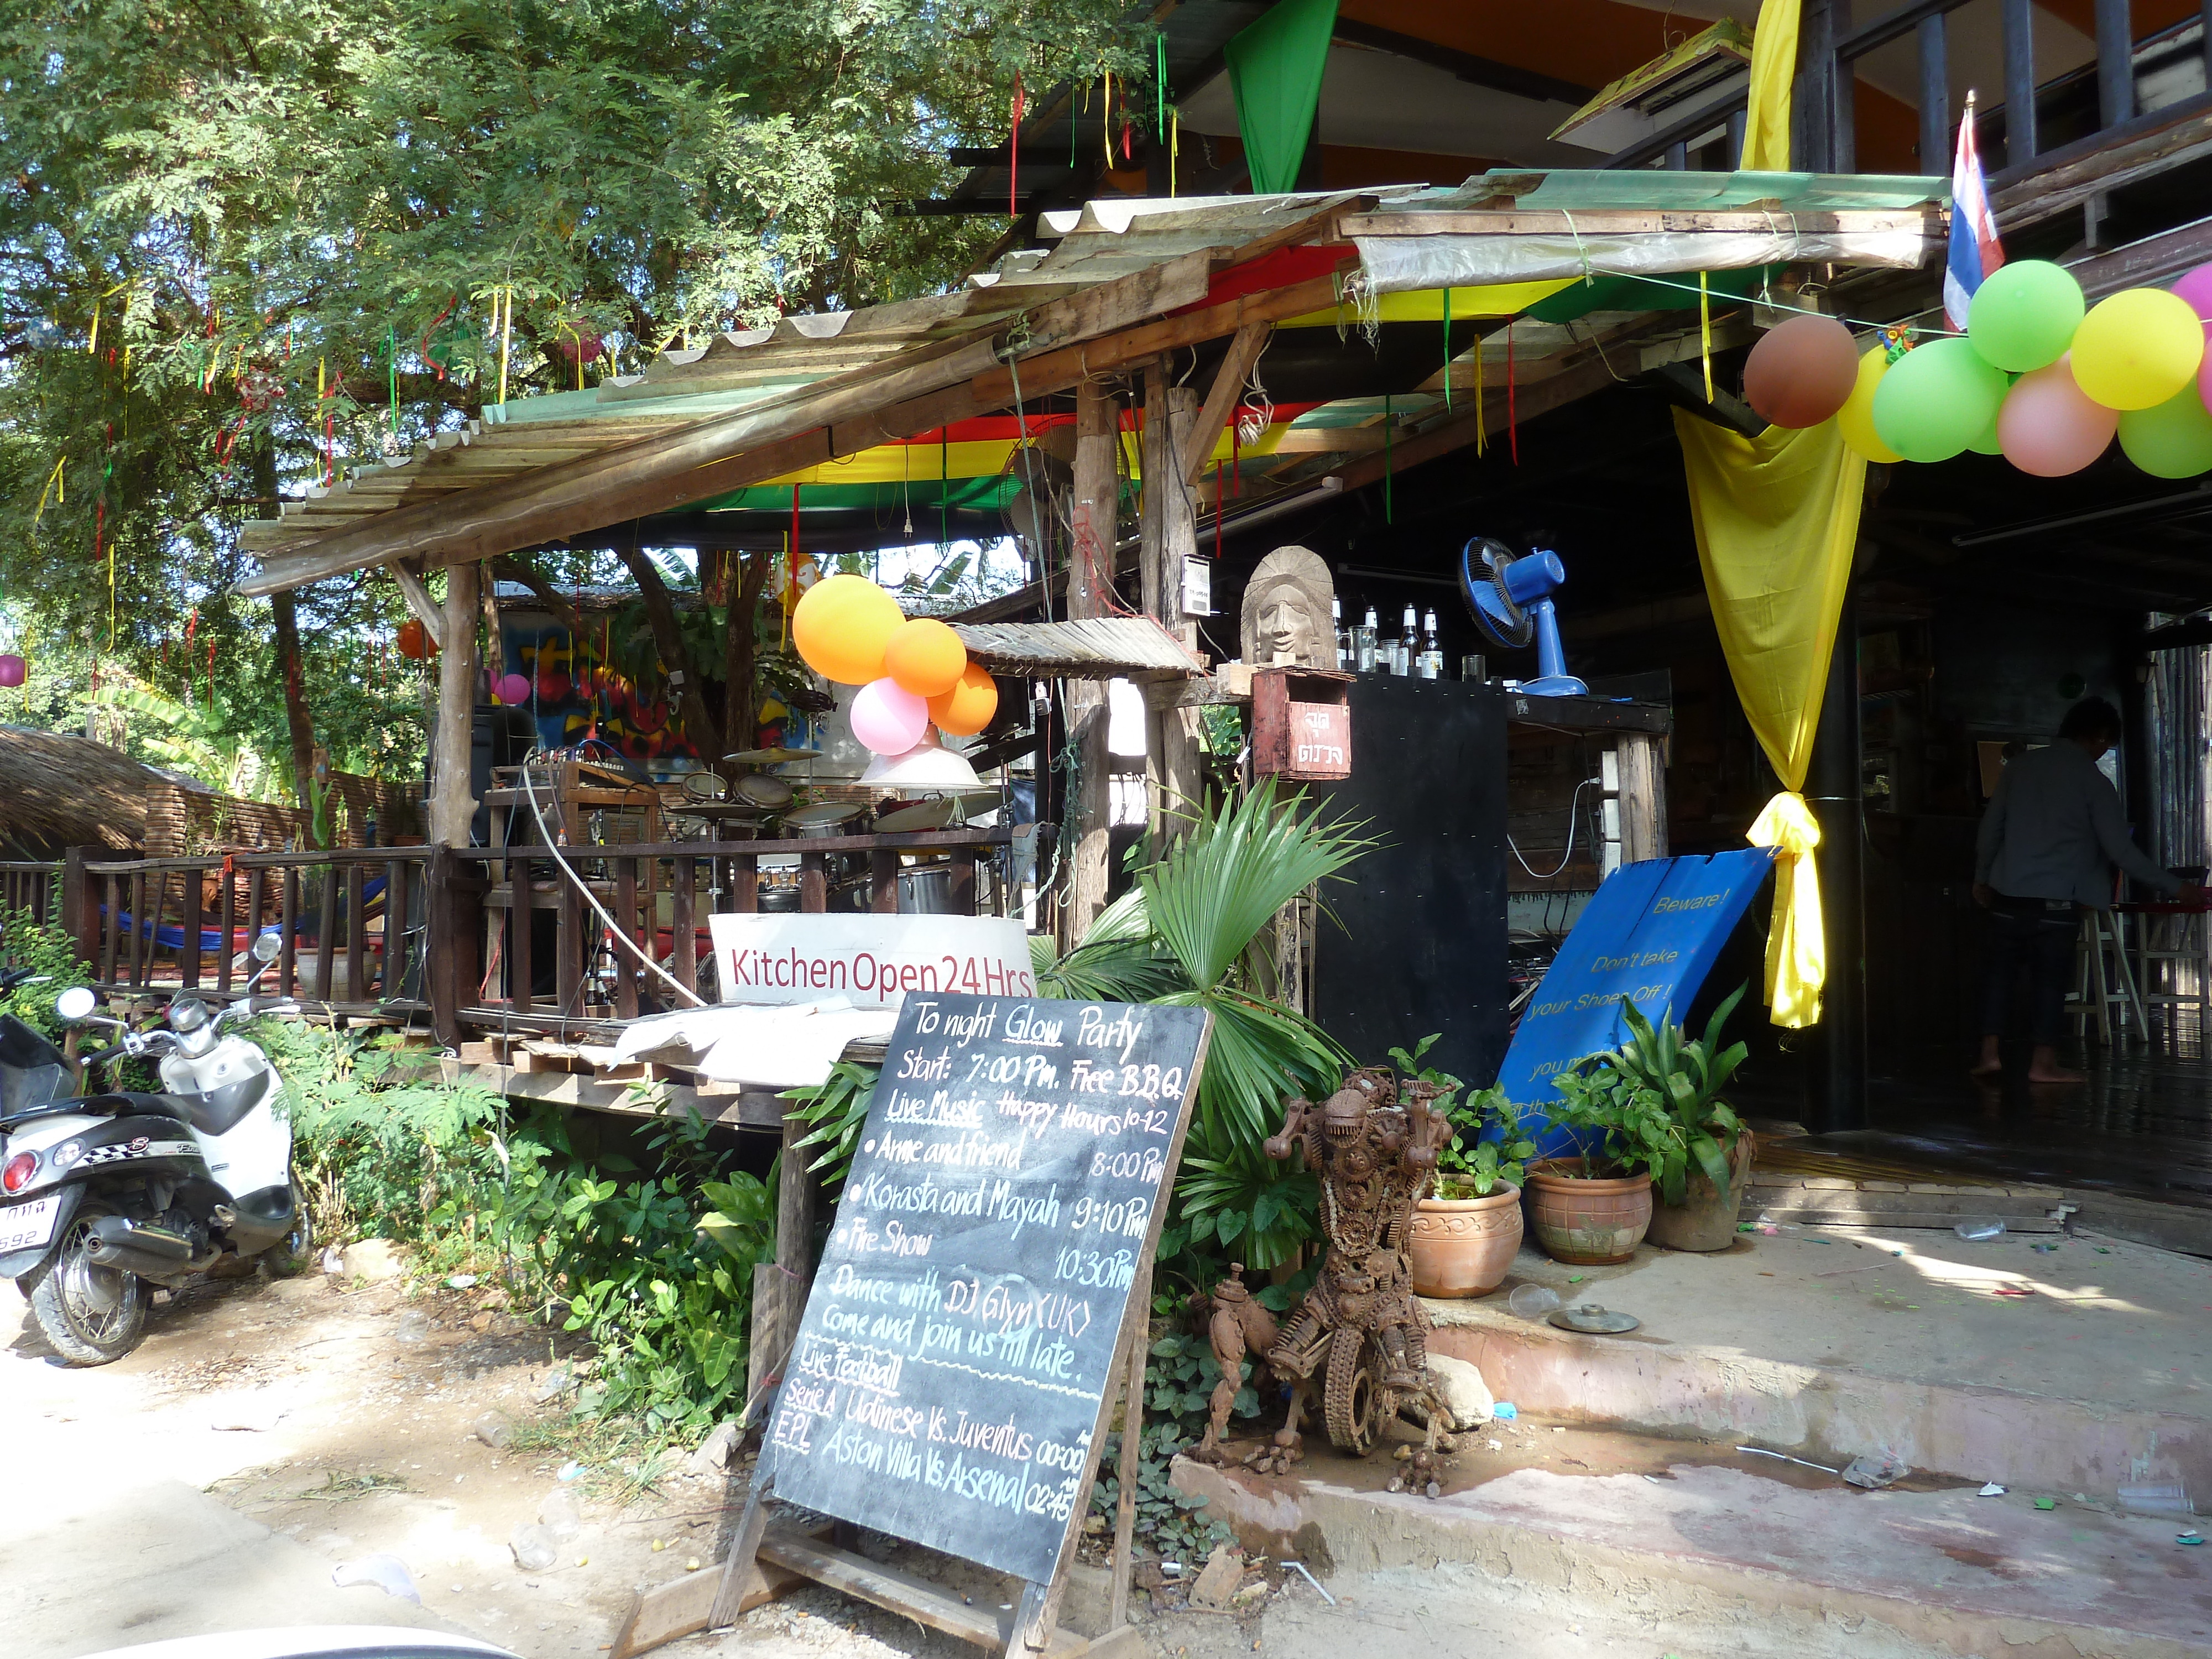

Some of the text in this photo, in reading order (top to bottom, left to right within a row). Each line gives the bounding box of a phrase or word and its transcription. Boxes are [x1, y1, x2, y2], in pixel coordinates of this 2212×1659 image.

[732, 947, 1032, 1002] Kitchen Open 24 Hrs
[1591, 949, 1678, 973] Don't take
[1005, 1003, 1063, 1042] Glow
[1077, 1005, 1144, 1065] Party
[1527, 1000, 1572, 1021] your
[897, 1047, 952, 1081] Start:
[966, 1053, 1020, 1083] 7:00
[1071, 1060, 1114, 1093] Free
[1528, 1060, 1563, 1082] you
[887, 1088, 925, 1119] Live
[930, 1087, 986, 1121] Music
[997, 1090, 1058, 1140] Happy
[1059, 1102, 1121, 1135] Hours
[924, 1131, 966, 1165] and
[966, 1127, 1027, 1170] friend
[940, 1178, 985, 1216] and
[988, 1179, 1060, 1240] Mayah
[881, 1219, 933, 1257] Show
[830, 1264, 893, 1305] Dance
[898, 1265, 941, 1312] with
[944, 1278, 979, 1314] DJ
[982, 1285, 1034, 1336] Glyn
[800, 1341, 902, 1390] Live Football
[822, 1303, 869, 1335] Come
[874, 1312, 917, 1347] and
[907, 1318, 962, 1361] join
[968, 1330, 995, 1357] us
[1030, 1332, 1082, 1381] late.
[785, 1378, 825, 1407] Serie
[825, 1384, 836, 1412] A
[846, 1389, 924, 1438] Udinese
[950, 1411, 1033, 1460] Juventus
[1036, 1440, 1085, 1474] 00:00
[775, 1410, 811, 1447] EPL
[822, 1425, 882, 1473] Aston
[887, 1439, 921, 1482] Villa
[942, 1452, 1030, 1514] Arsenal
[1025, 1483, 1073, 1521] 02:45
